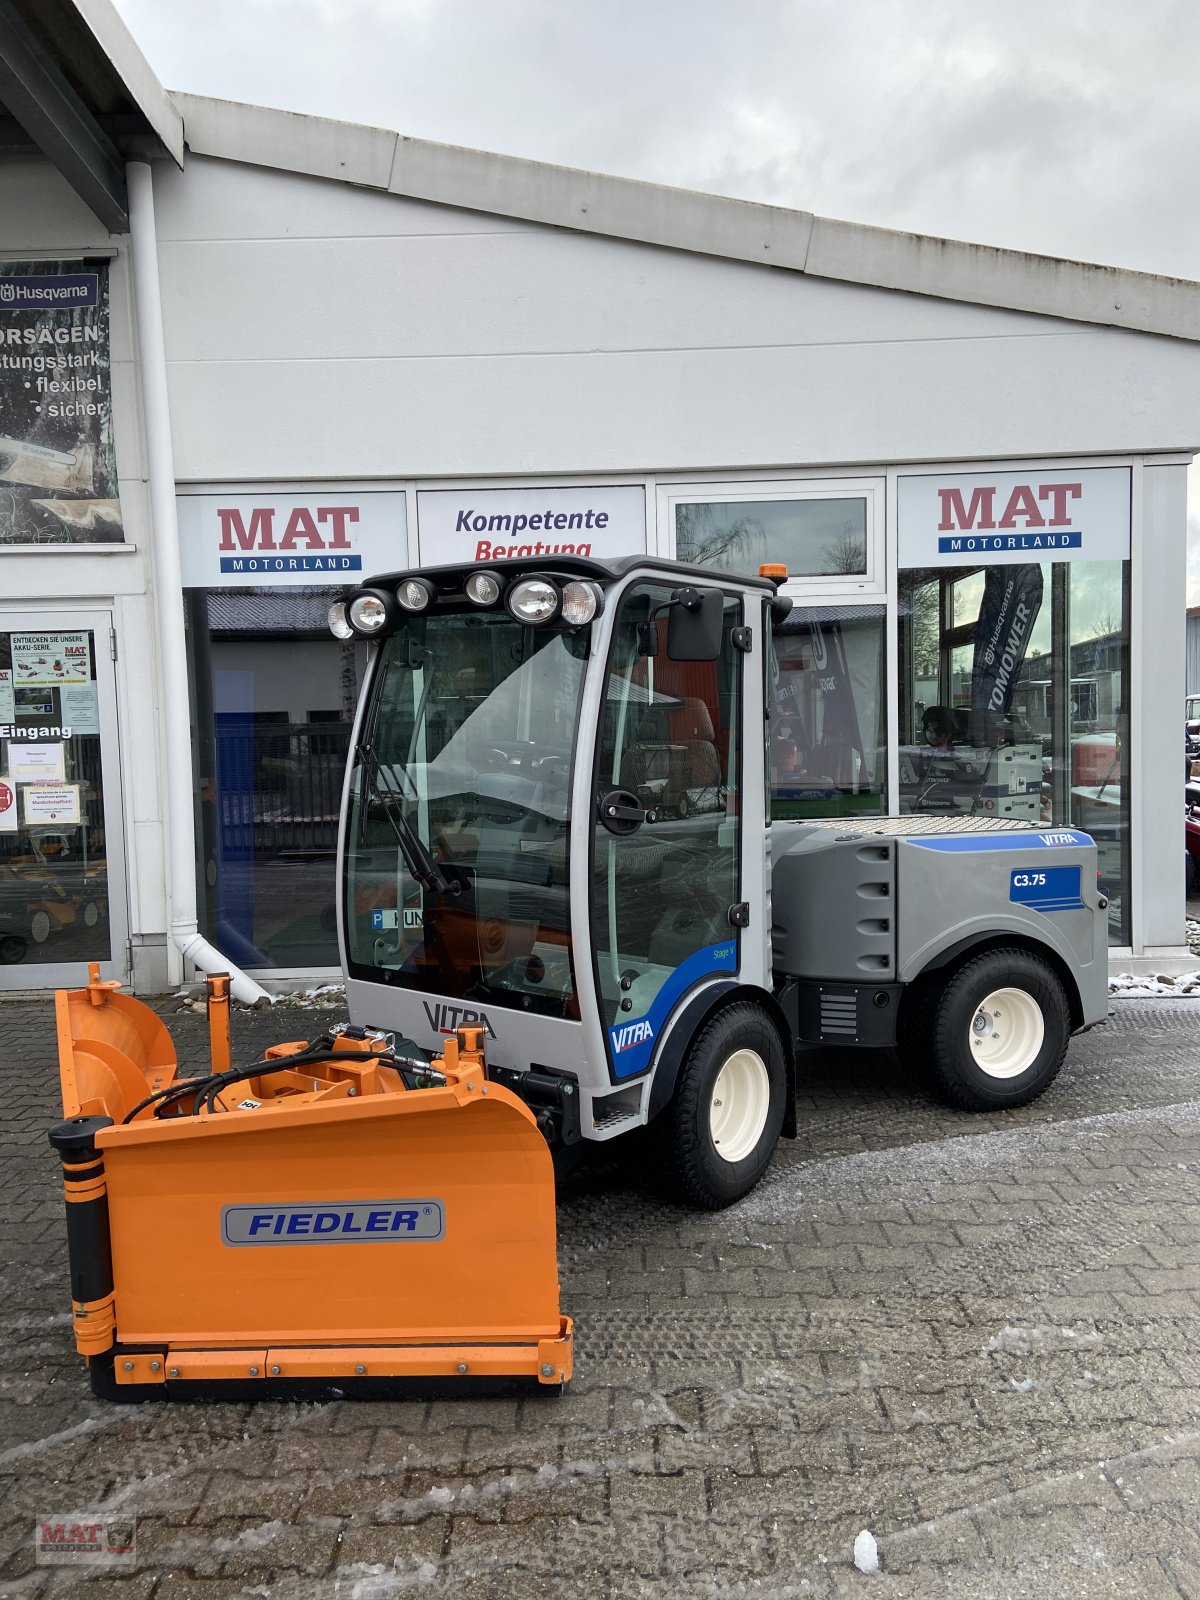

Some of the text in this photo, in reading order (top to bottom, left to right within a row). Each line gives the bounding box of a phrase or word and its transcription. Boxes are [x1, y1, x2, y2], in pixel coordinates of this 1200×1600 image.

[16, 285, 88, 301] Husqvarna
[0, 325, 98, 344] RSÄGEN
[0, 350, 99, 373] tungsstark
[36, 375, 102, 393] flexibel
[48, 401, 103, 417] sicher
[938, 483, 1082, 530] MAT
[217, 507, 360, 550] MAT
[455, 509, 609, 536] Kompetente
[951, 535, 1070, 550] MOTORLAND
[233, 558, 350, 570] MOTORLAND
[989, 580, 1014, 650] Husqvarna
[13, 636, 48, 644] ENTDECKEN
[64, 646, 86, 654] MAT
[0, 725, 72, 739] Eingang
[1038, 833, 1078, 847] VITRA
[1013, 874, 1046, 887] C3.75
[714, 948, 729, 960] Stage
[612, 1020, 654, 1053] VITRA
